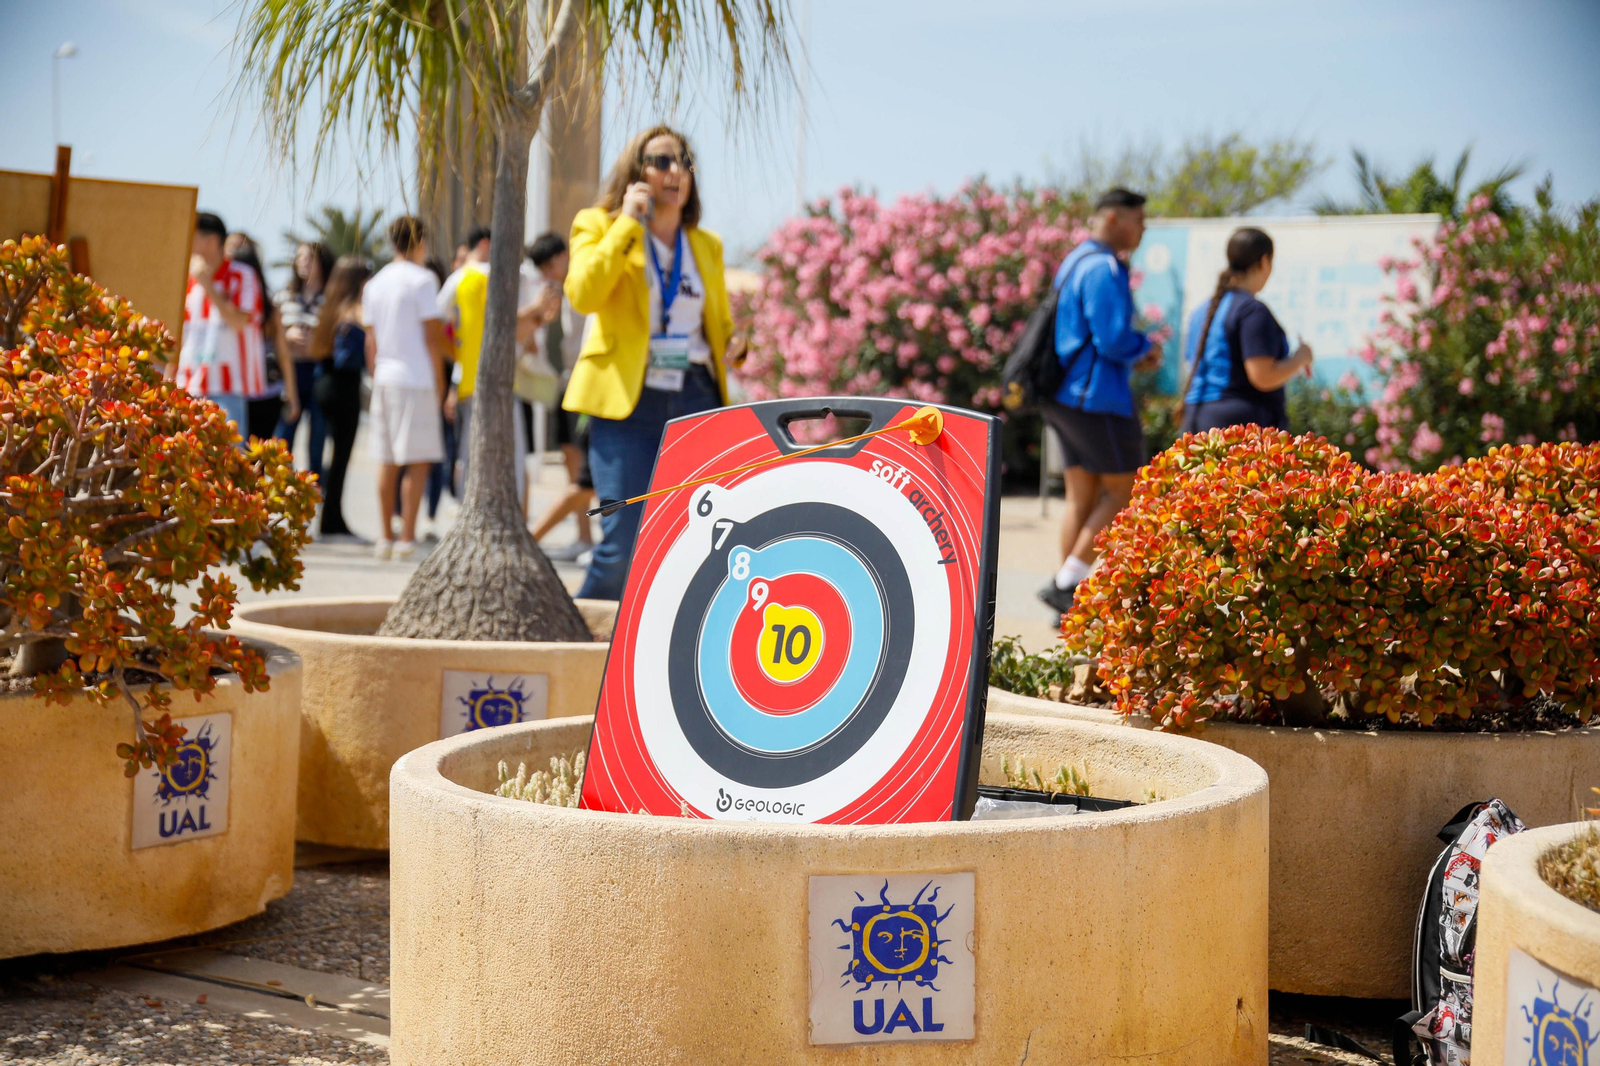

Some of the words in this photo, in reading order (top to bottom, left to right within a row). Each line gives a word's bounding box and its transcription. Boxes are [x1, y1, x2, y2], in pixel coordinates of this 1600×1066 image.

[697, 490, 713, 517] 6
[869, 460, 911, 492] soft
[909, 490, 957, 565] archery
[716, 522, 734, 550] 7
[732, 552, 750, 580] 8
[751, 582, 769, 611] 9
[771, 624, 811, 665] 10
[159, 804, 211, 838] UAL
[853, 997, 945, 1035] UAL
